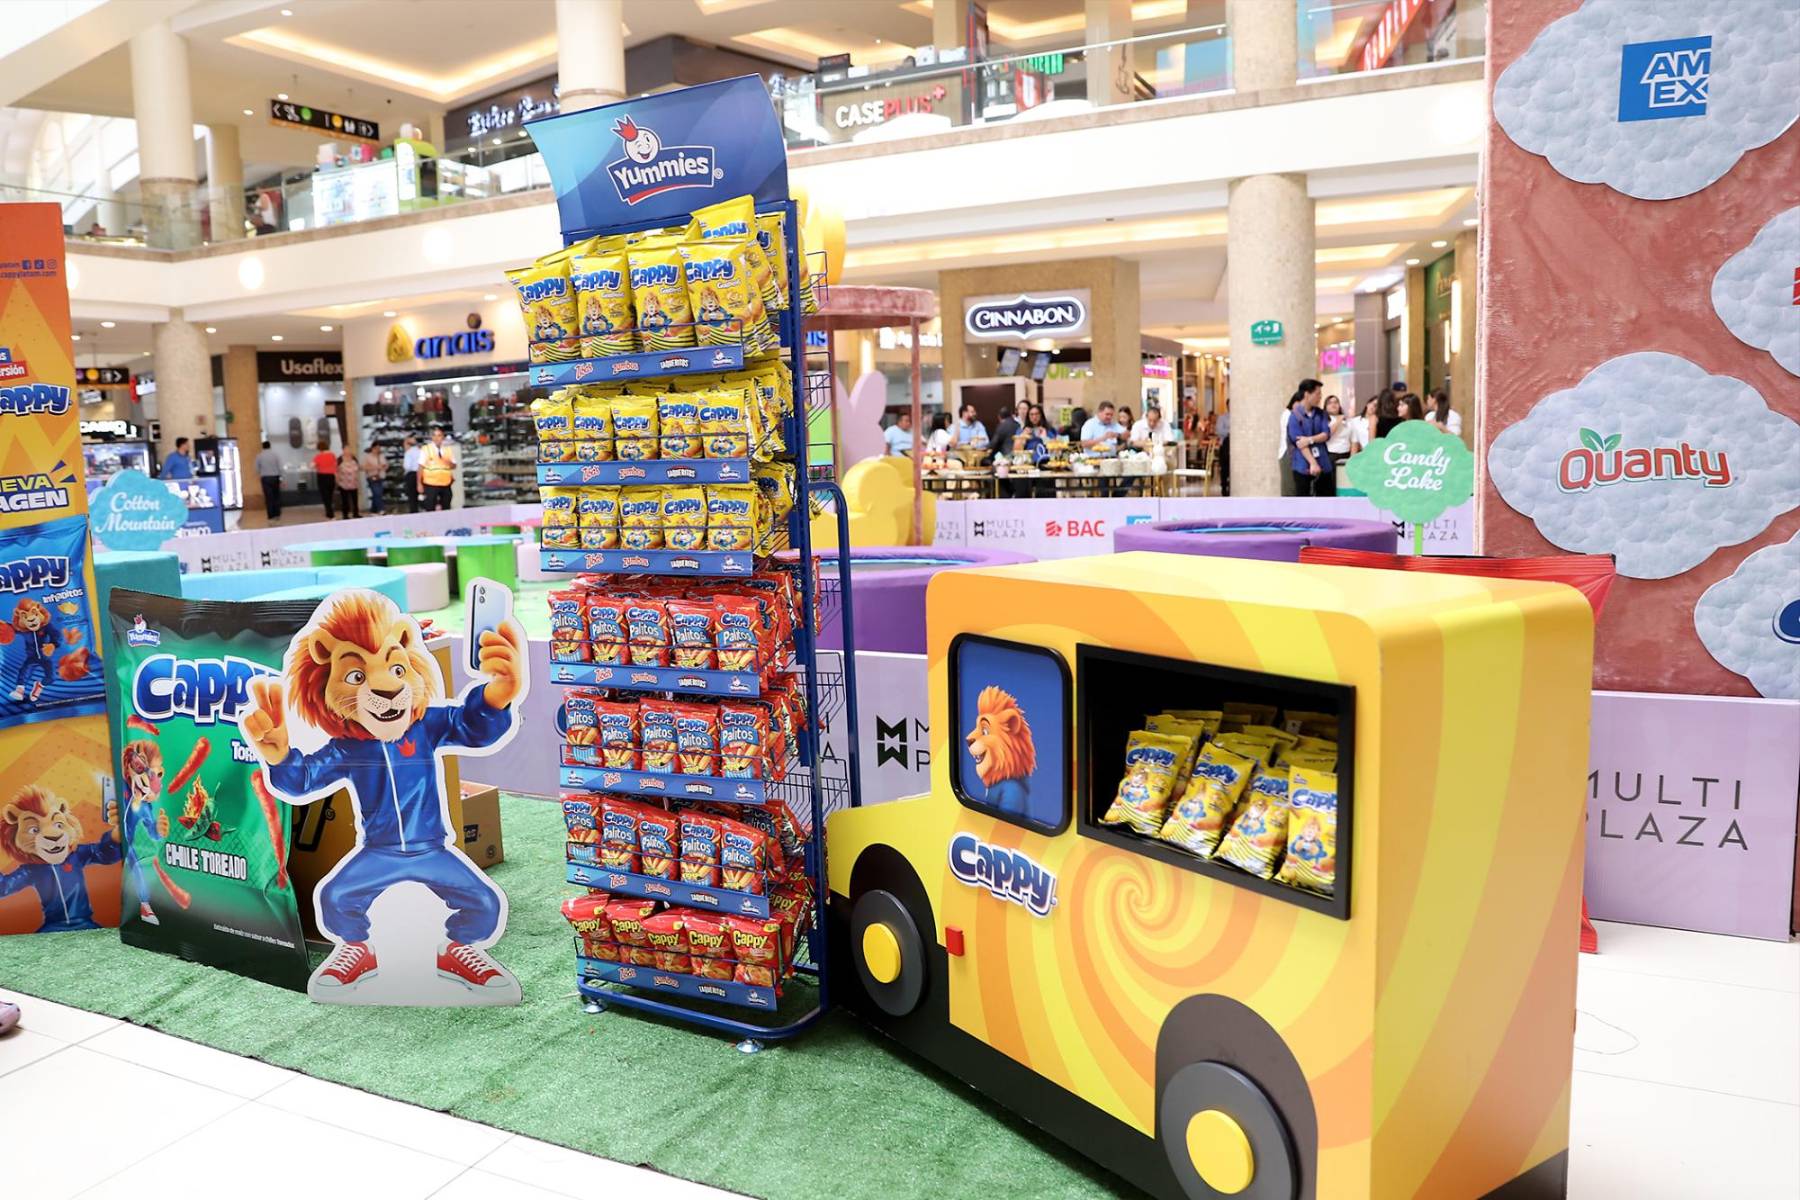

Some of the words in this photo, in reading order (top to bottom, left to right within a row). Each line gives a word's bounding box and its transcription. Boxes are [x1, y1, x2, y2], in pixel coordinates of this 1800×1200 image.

[614, 152, 710, 190] Yummies
[631, 264, 679, 289] Cappy
[684, 259, 735, 283] Cappy
[570, 270, 621, 291] Cappy
[975, 305, 1074, 329] CINNABON
[415, 314, 496, 360] anais
[281, 359, 343, 375] Usaflex
[660, 404, 699, 420] Cappy
[700, 406, 740, 423] Cappy
[536, 415, 569, 431] Cappy
[573, 416, 605, 431] Cappy
[613, 416, 650, 431] Cappy
[1383, 442, 1452, 475] Candy
[1559, 442, 1731, 490] Quanty
[1384, 467, 1444, 491] Lake
[110, 491, 161, 513] Cotton
[579, 500, 615, 515] Cappy
[622, 500, 660, 516] Cappy
[664, 499, 704, 515] Cappy
[707, 499, 750, 516] Cappy
[95, 514, 176, 533] Mountain
[985, 519, 1025, 530] MULTI
[1067, 520, 1105, 537] BAC
[985, 529, 1026, 539] PLAZA
[1408, 531, 1459, 541] PAZA
[590, 606, 619, 620] Cappy
[674, 613, 709, 628] Cappy
[592, 621, 617, 635] Palitos
[630, 623, 659, 637] Palitos
[676, 628, 707, 642] Palitos
[723, 627, 752, 644] Palitos
[133, 654, 272, 724] Capp
[567, 711, 594, 725] alitos
[602, 727, 628, 741] Palitos
[645, 724, 673, 739] Palitos
[679, 732, 708, 747] Palitos
[722, 726, 754, 744] Palitos
[603, 826, 632, 841] Palitos
[681, 822, 715, 839] Cappy
[1586, 809, 1749, 851] LAZA
[642, 836, 667, 851] Palitos
[682, 838, 711, 853] Palitos
[724, 832, 754, 852] Cappy
[165, 843, 199, 871] CHILE
[200, 850, 247, 880] TOREADO
[723, 850, 751, 865] Palitos
[949, 832, 1056, 915] Cappy
[769, 893, 798, 911] appy
[572, 919, 600, 933] Cappy
[648, 933, 679, 946] Cappy
[688, 931, 724, 948] Cappy
[733, 930, 768, 949] Cappy
